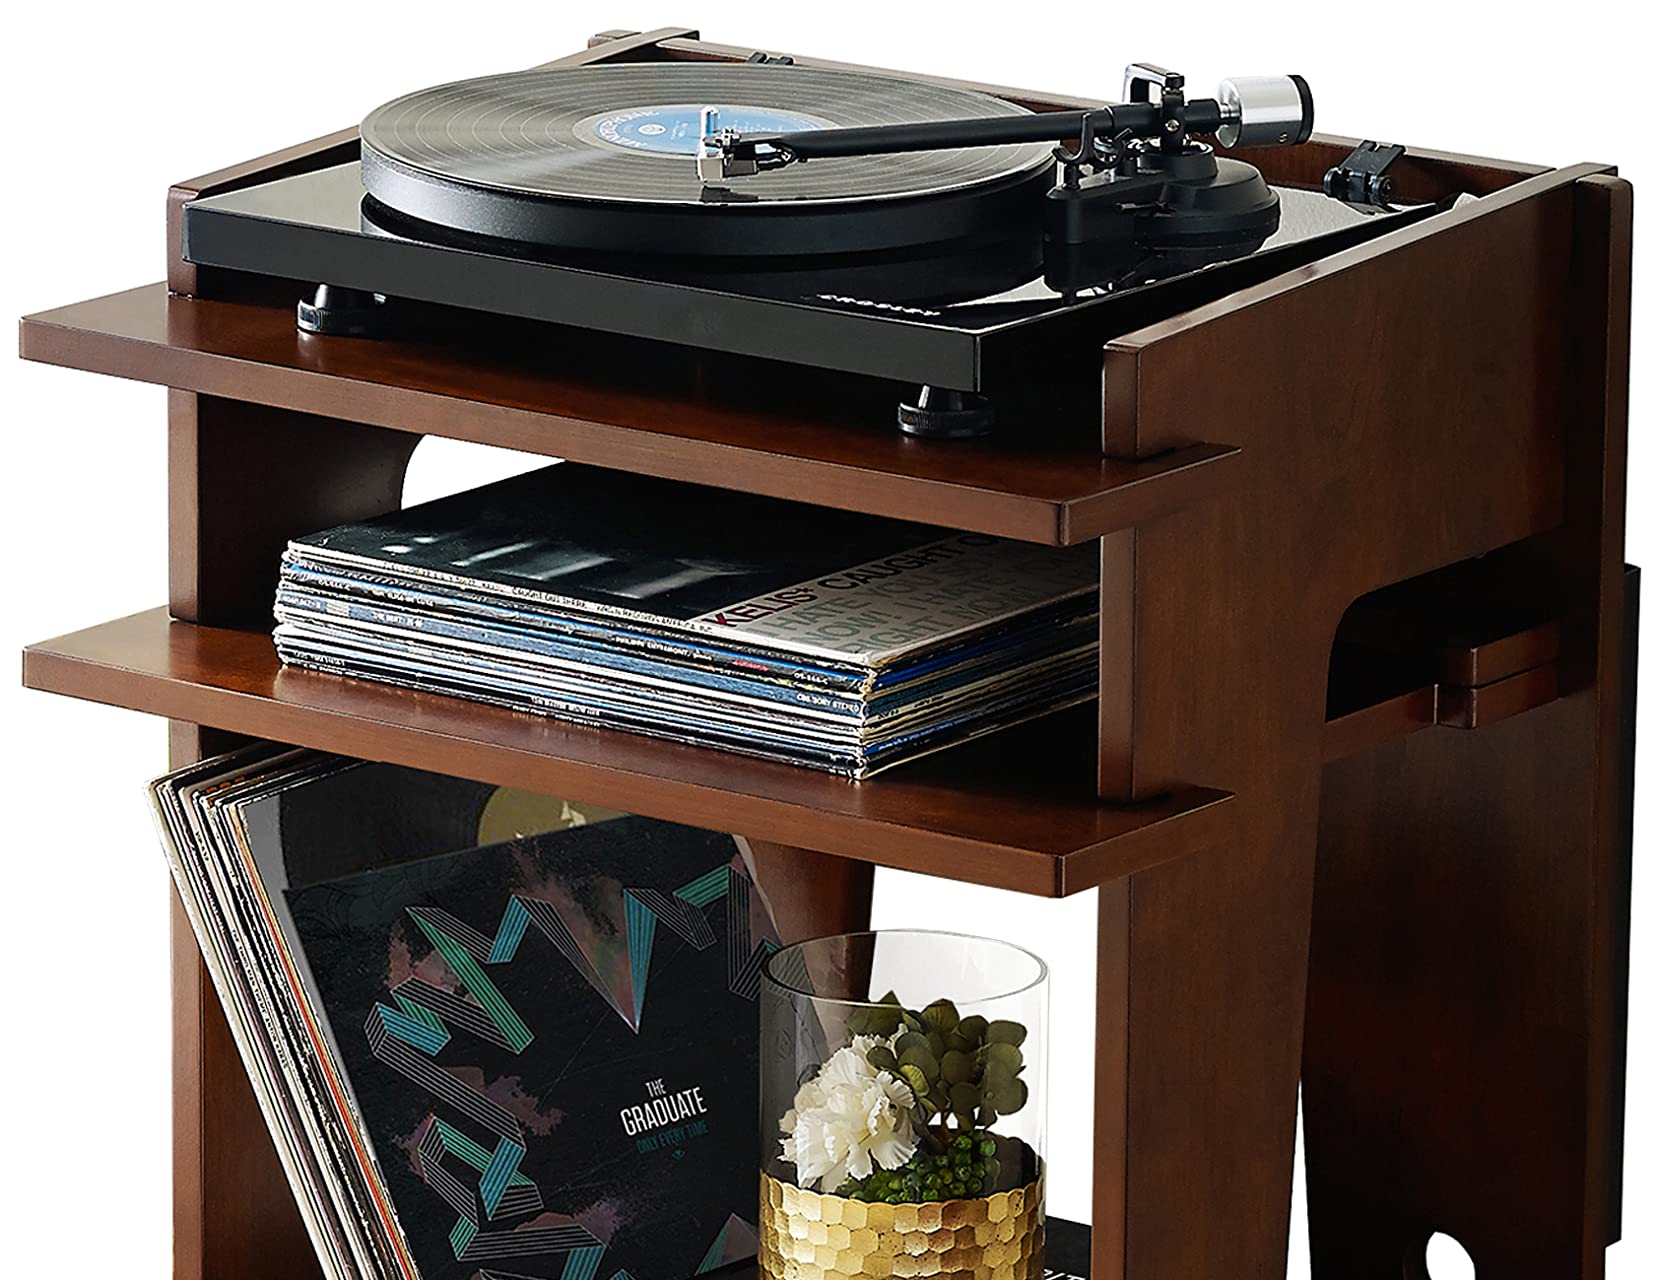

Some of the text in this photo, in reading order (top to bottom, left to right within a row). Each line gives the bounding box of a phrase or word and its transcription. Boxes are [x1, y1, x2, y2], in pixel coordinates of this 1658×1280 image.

[817, 544, 965, 591] CAUGHT
[762, 597, 873, 631] HATE
[645, 1078, 667, 1098] THE
[620, 1086, 708, 1136] GRADUATE
